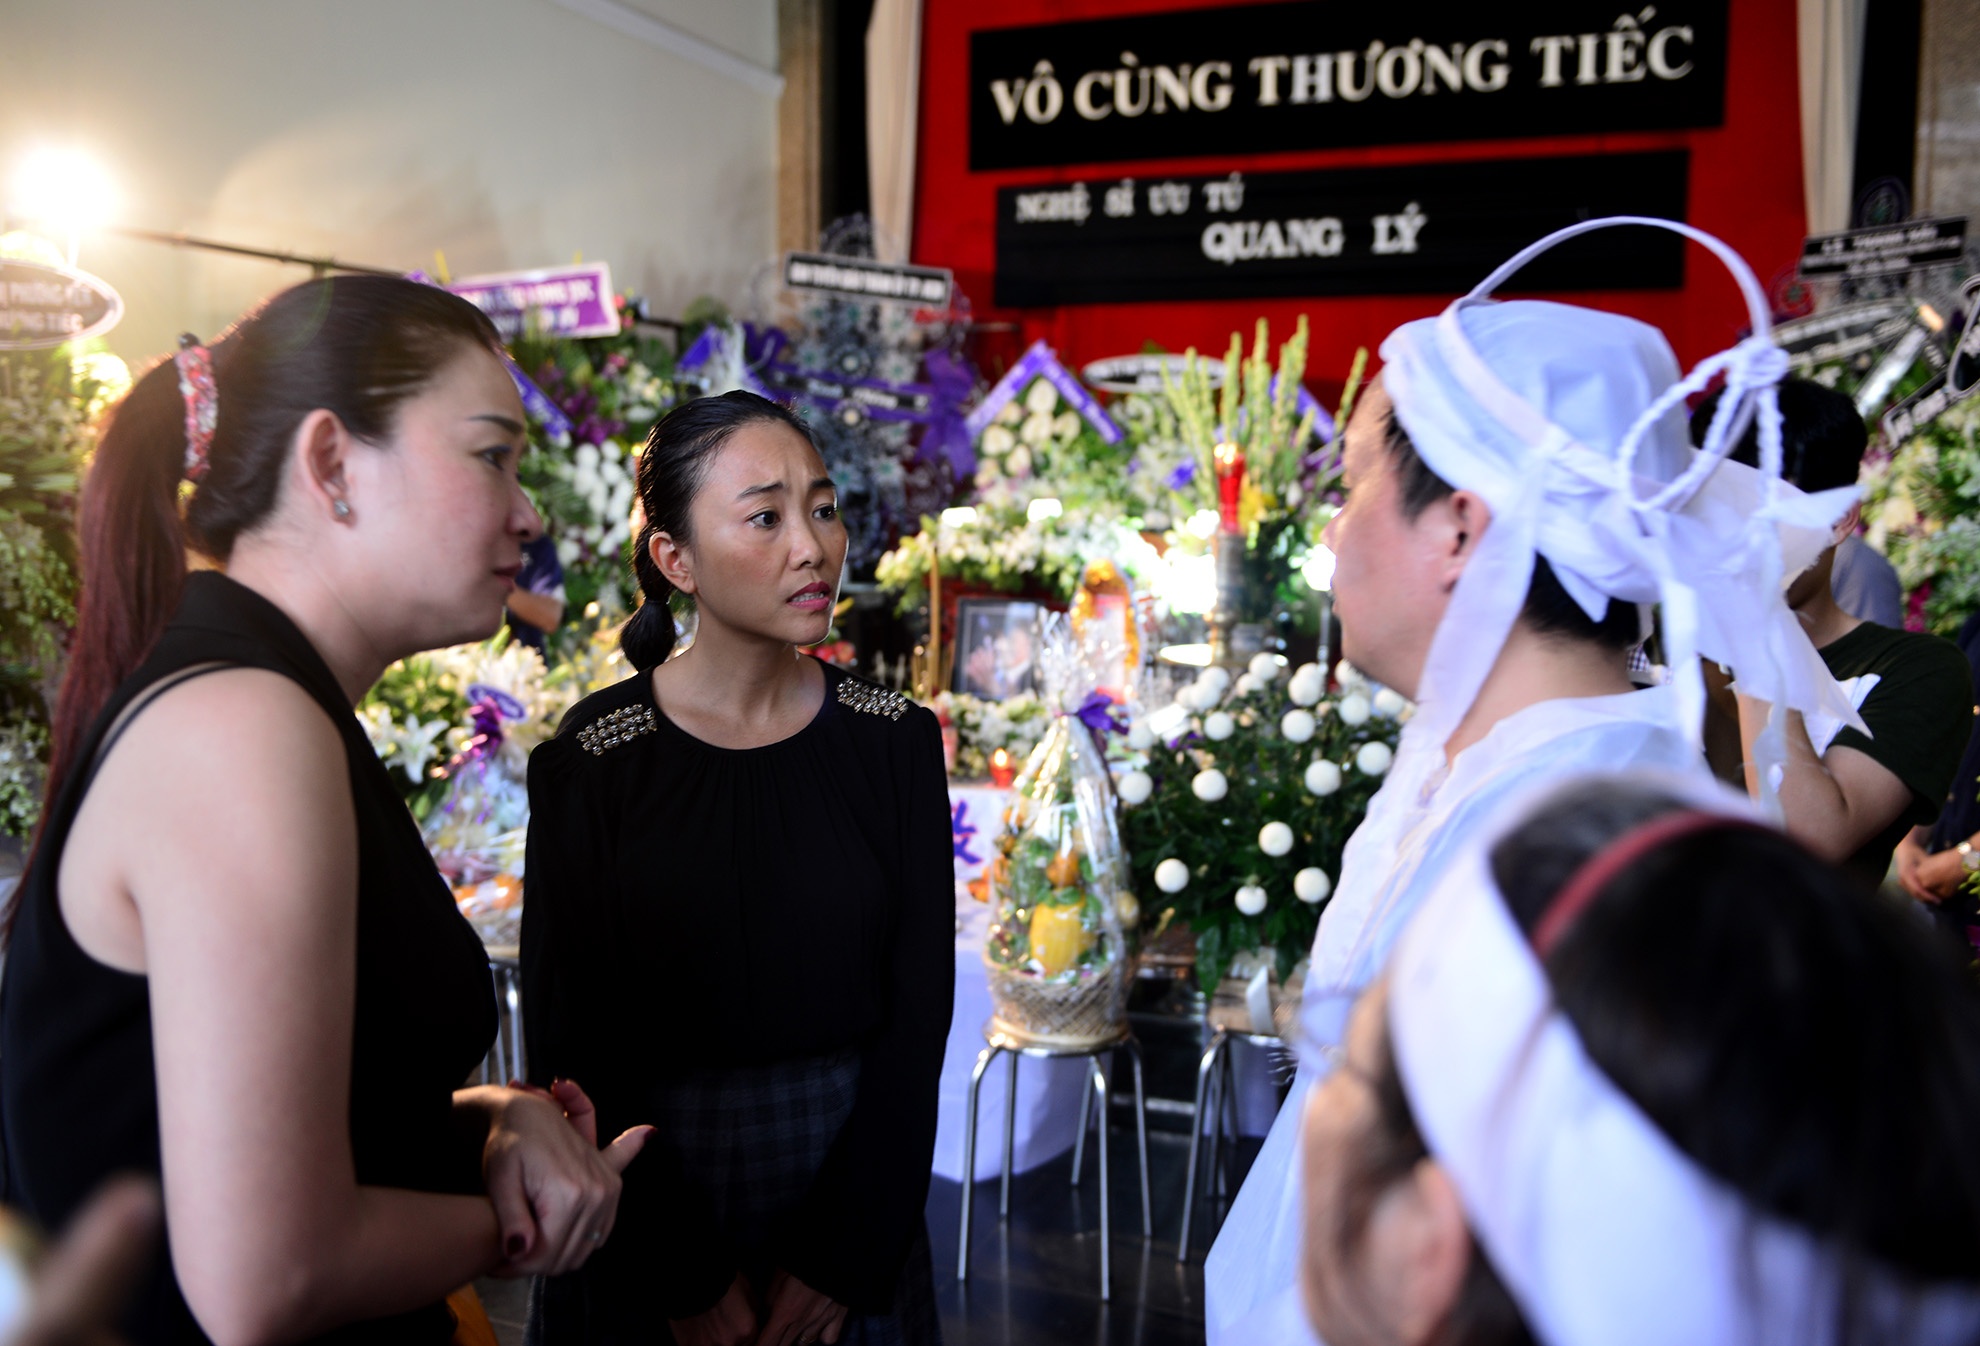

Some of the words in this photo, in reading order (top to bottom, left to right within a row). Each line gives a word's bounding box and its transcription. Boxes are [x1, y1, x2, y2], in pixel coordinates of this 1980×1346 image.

[992, 60, 1063, 124] VÔ
[1073, 52, 1234, 120] CÙNG
[1249, 38, 1510, 105] THƯƠNG
[1530, 5, 1694, 88] TIẾC
[1201, 209, 1345, 265] QUANG
[1372, 202, 1427, 255] LÝ
